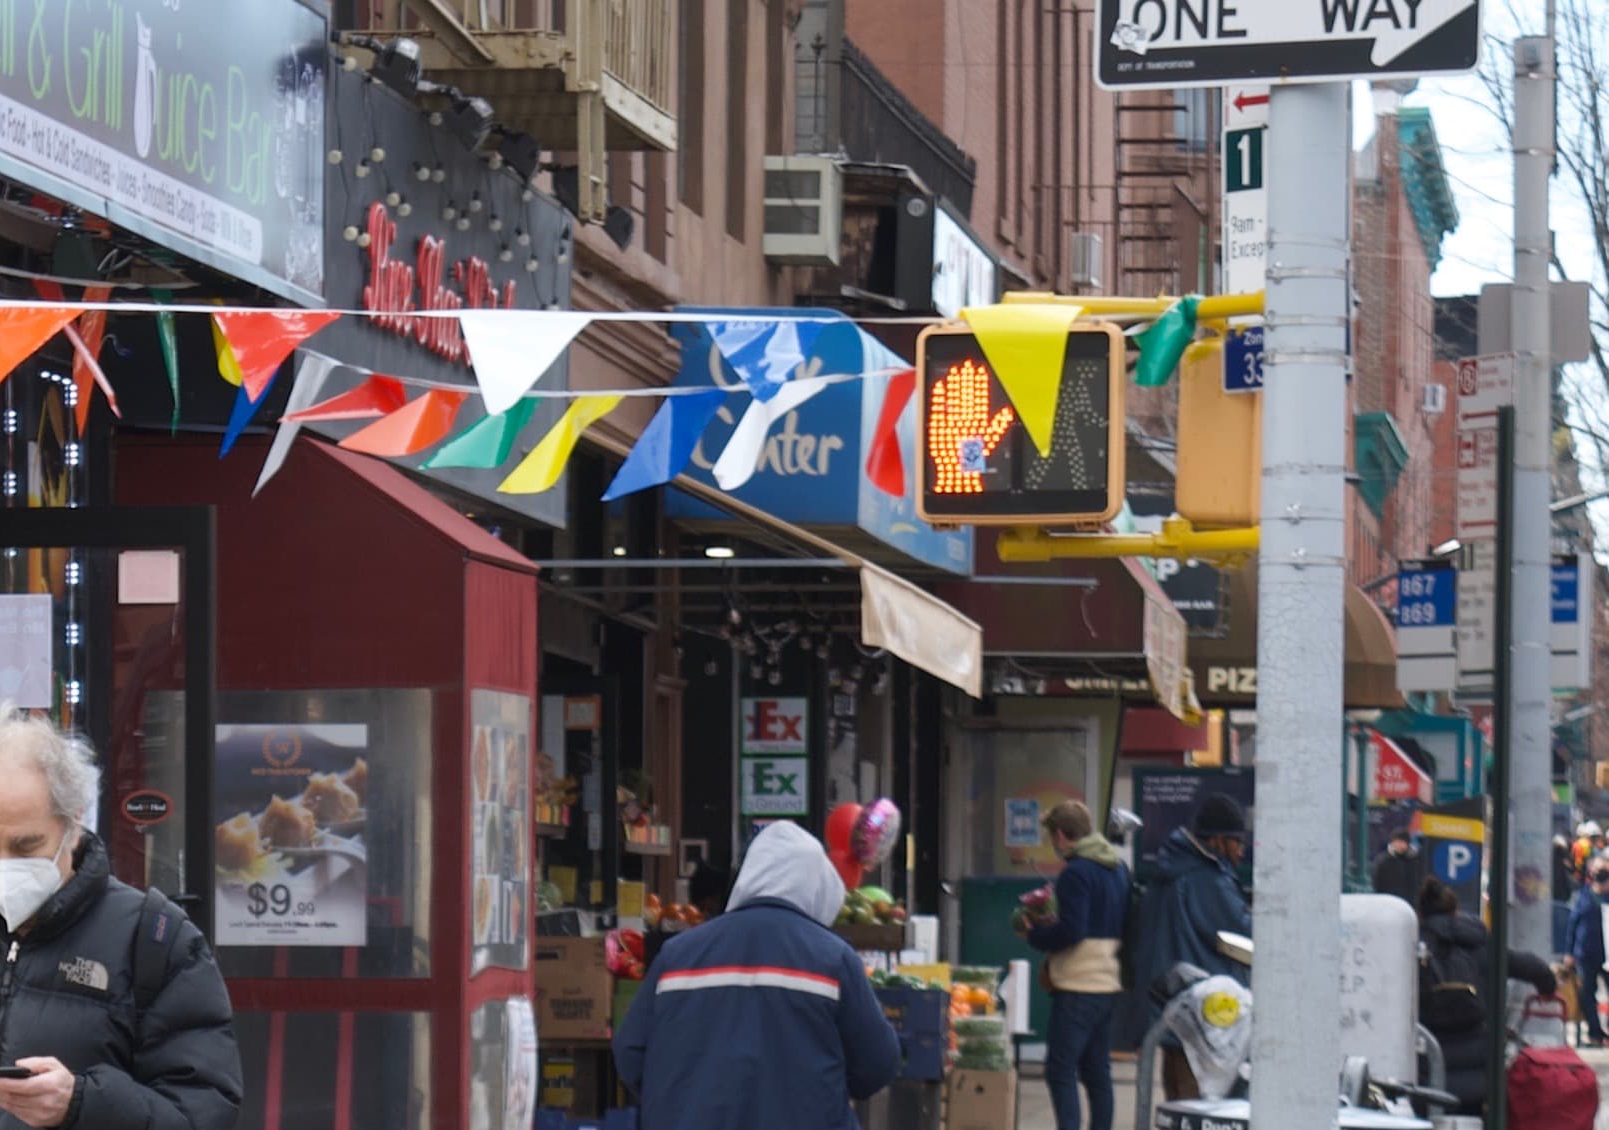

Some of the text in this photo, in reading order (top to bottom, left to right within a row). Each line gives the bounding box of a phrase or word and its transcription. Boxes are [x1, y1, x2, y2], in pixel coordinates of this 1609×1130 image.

[1133, 0, 1426, 42] ONE WAY
[226, 64, 275, 203] Bar
[1236, 133, 1251, 187] 1
[1231, 241, 1264, 260] Excep
[1243, 331, 1264, 345] Zon
[690, 405, 844, 476] Cnter
[1401, 574, 1436, 597] B67
[1401, 602, 1436, 624] B69
[1208, 667, 1258, 692] PIZ
[753, 762, 797, 795] Ex
[1447, 844, 1472, 880] P
